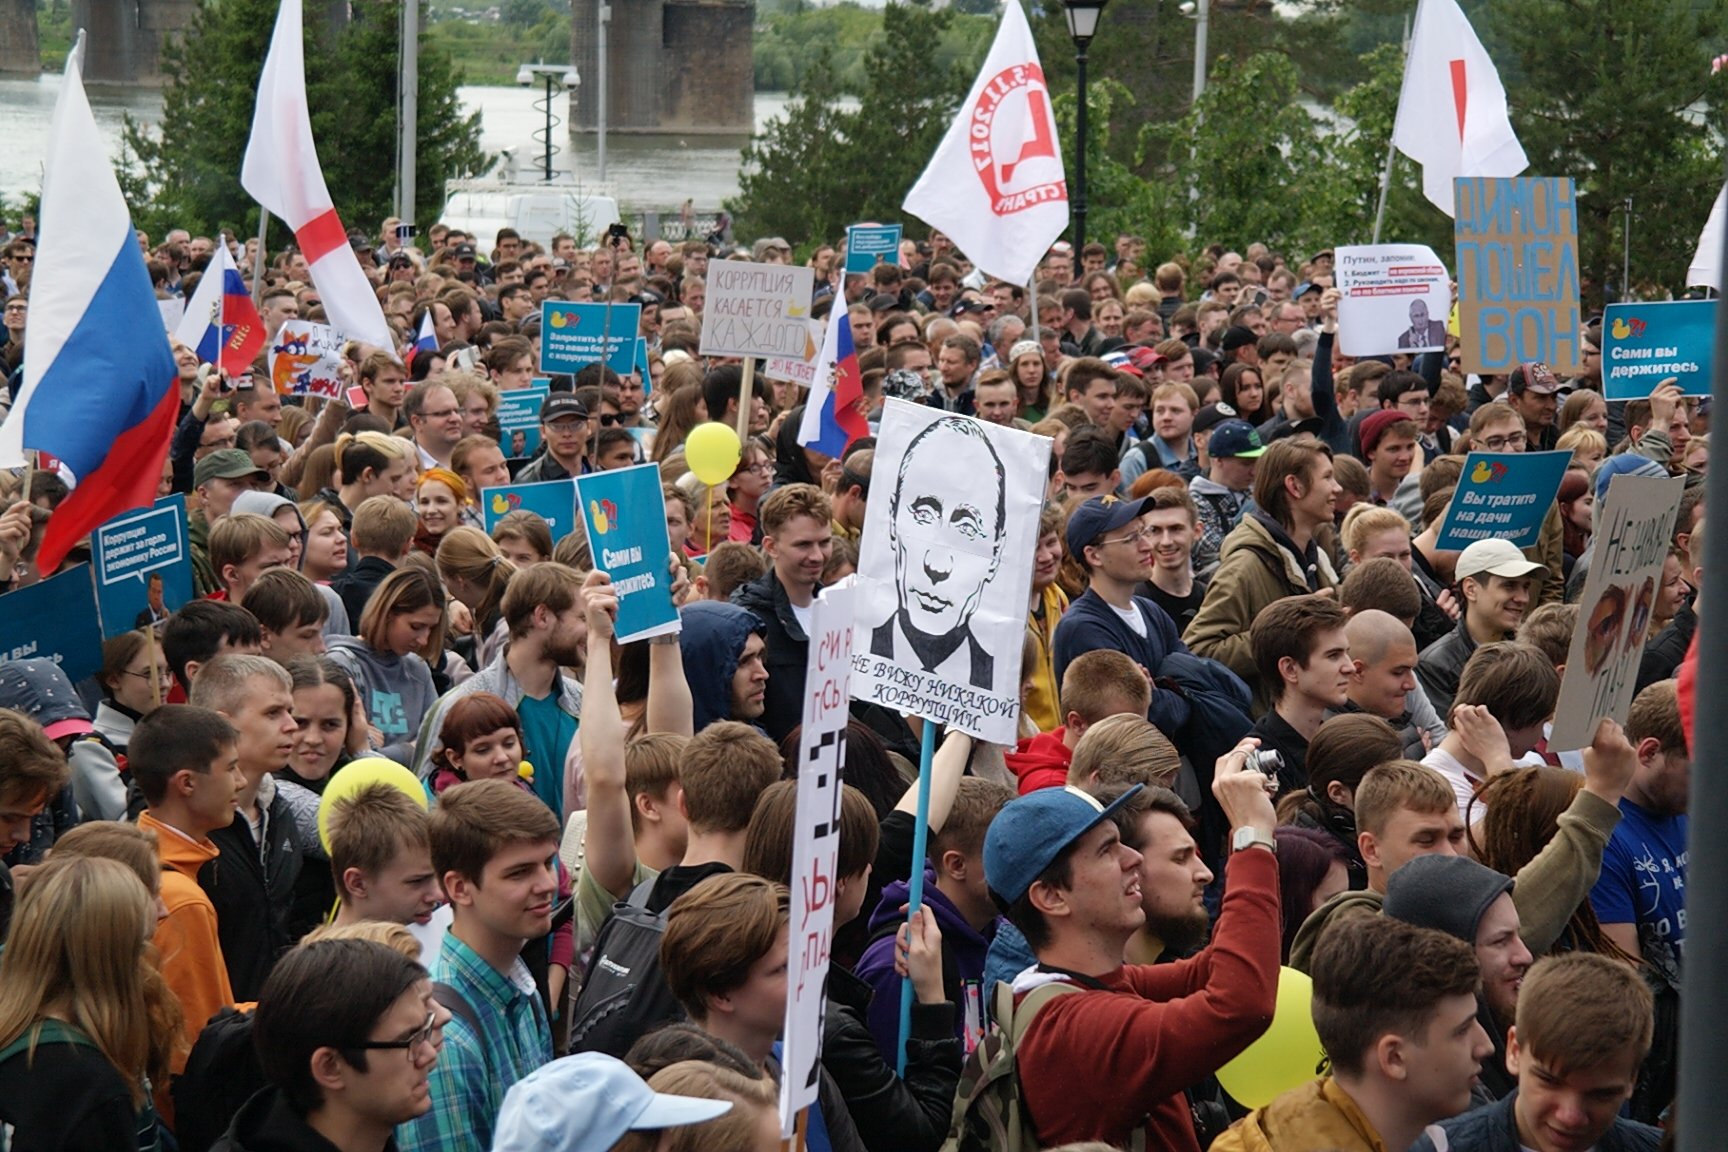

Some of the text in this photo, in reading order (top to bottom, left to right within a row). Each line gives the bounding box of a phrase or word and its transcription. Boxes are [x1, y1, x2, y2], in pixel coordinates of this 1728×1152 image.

[1455, 177, 1578, 236] ДИМОН
[1343, 255, 1379, 265] Путин,
[716, 271, 794, 294] КОРРУПЦИЯ
[1456, 240, 1580, 304] ПОШЕЛ
[714, 297, 783, 319] КАСАЕТСЯ
[549, 332, 623, 344] Запретить фльм
[710, 318, 806, 353] КАЖДОГО
[1480, 306, 1579, 369] ВОН
[1611, 346, 1678, 360] Сами вы
[1610, 362, 1699, 378] держитесь
[1462, 491, 1537, 508] Вы тратите
[1455, 511, 1512, 524] на дачи
[104, 526, 147, 546] Коррупция
[1449, 527, 1492, 540] наши
[105, 533, 167, 561] держит за горло
[106, 543, 178, 573] экономику России
[602, 546, 643, 570] Сами вы
[12, 640, 38, 660] вы
[851, 653, 1020, 719] НЕ ВИЖУ НИКАКОЙ
[872, 683, 982, 732] КОРРУПЦИИ.
